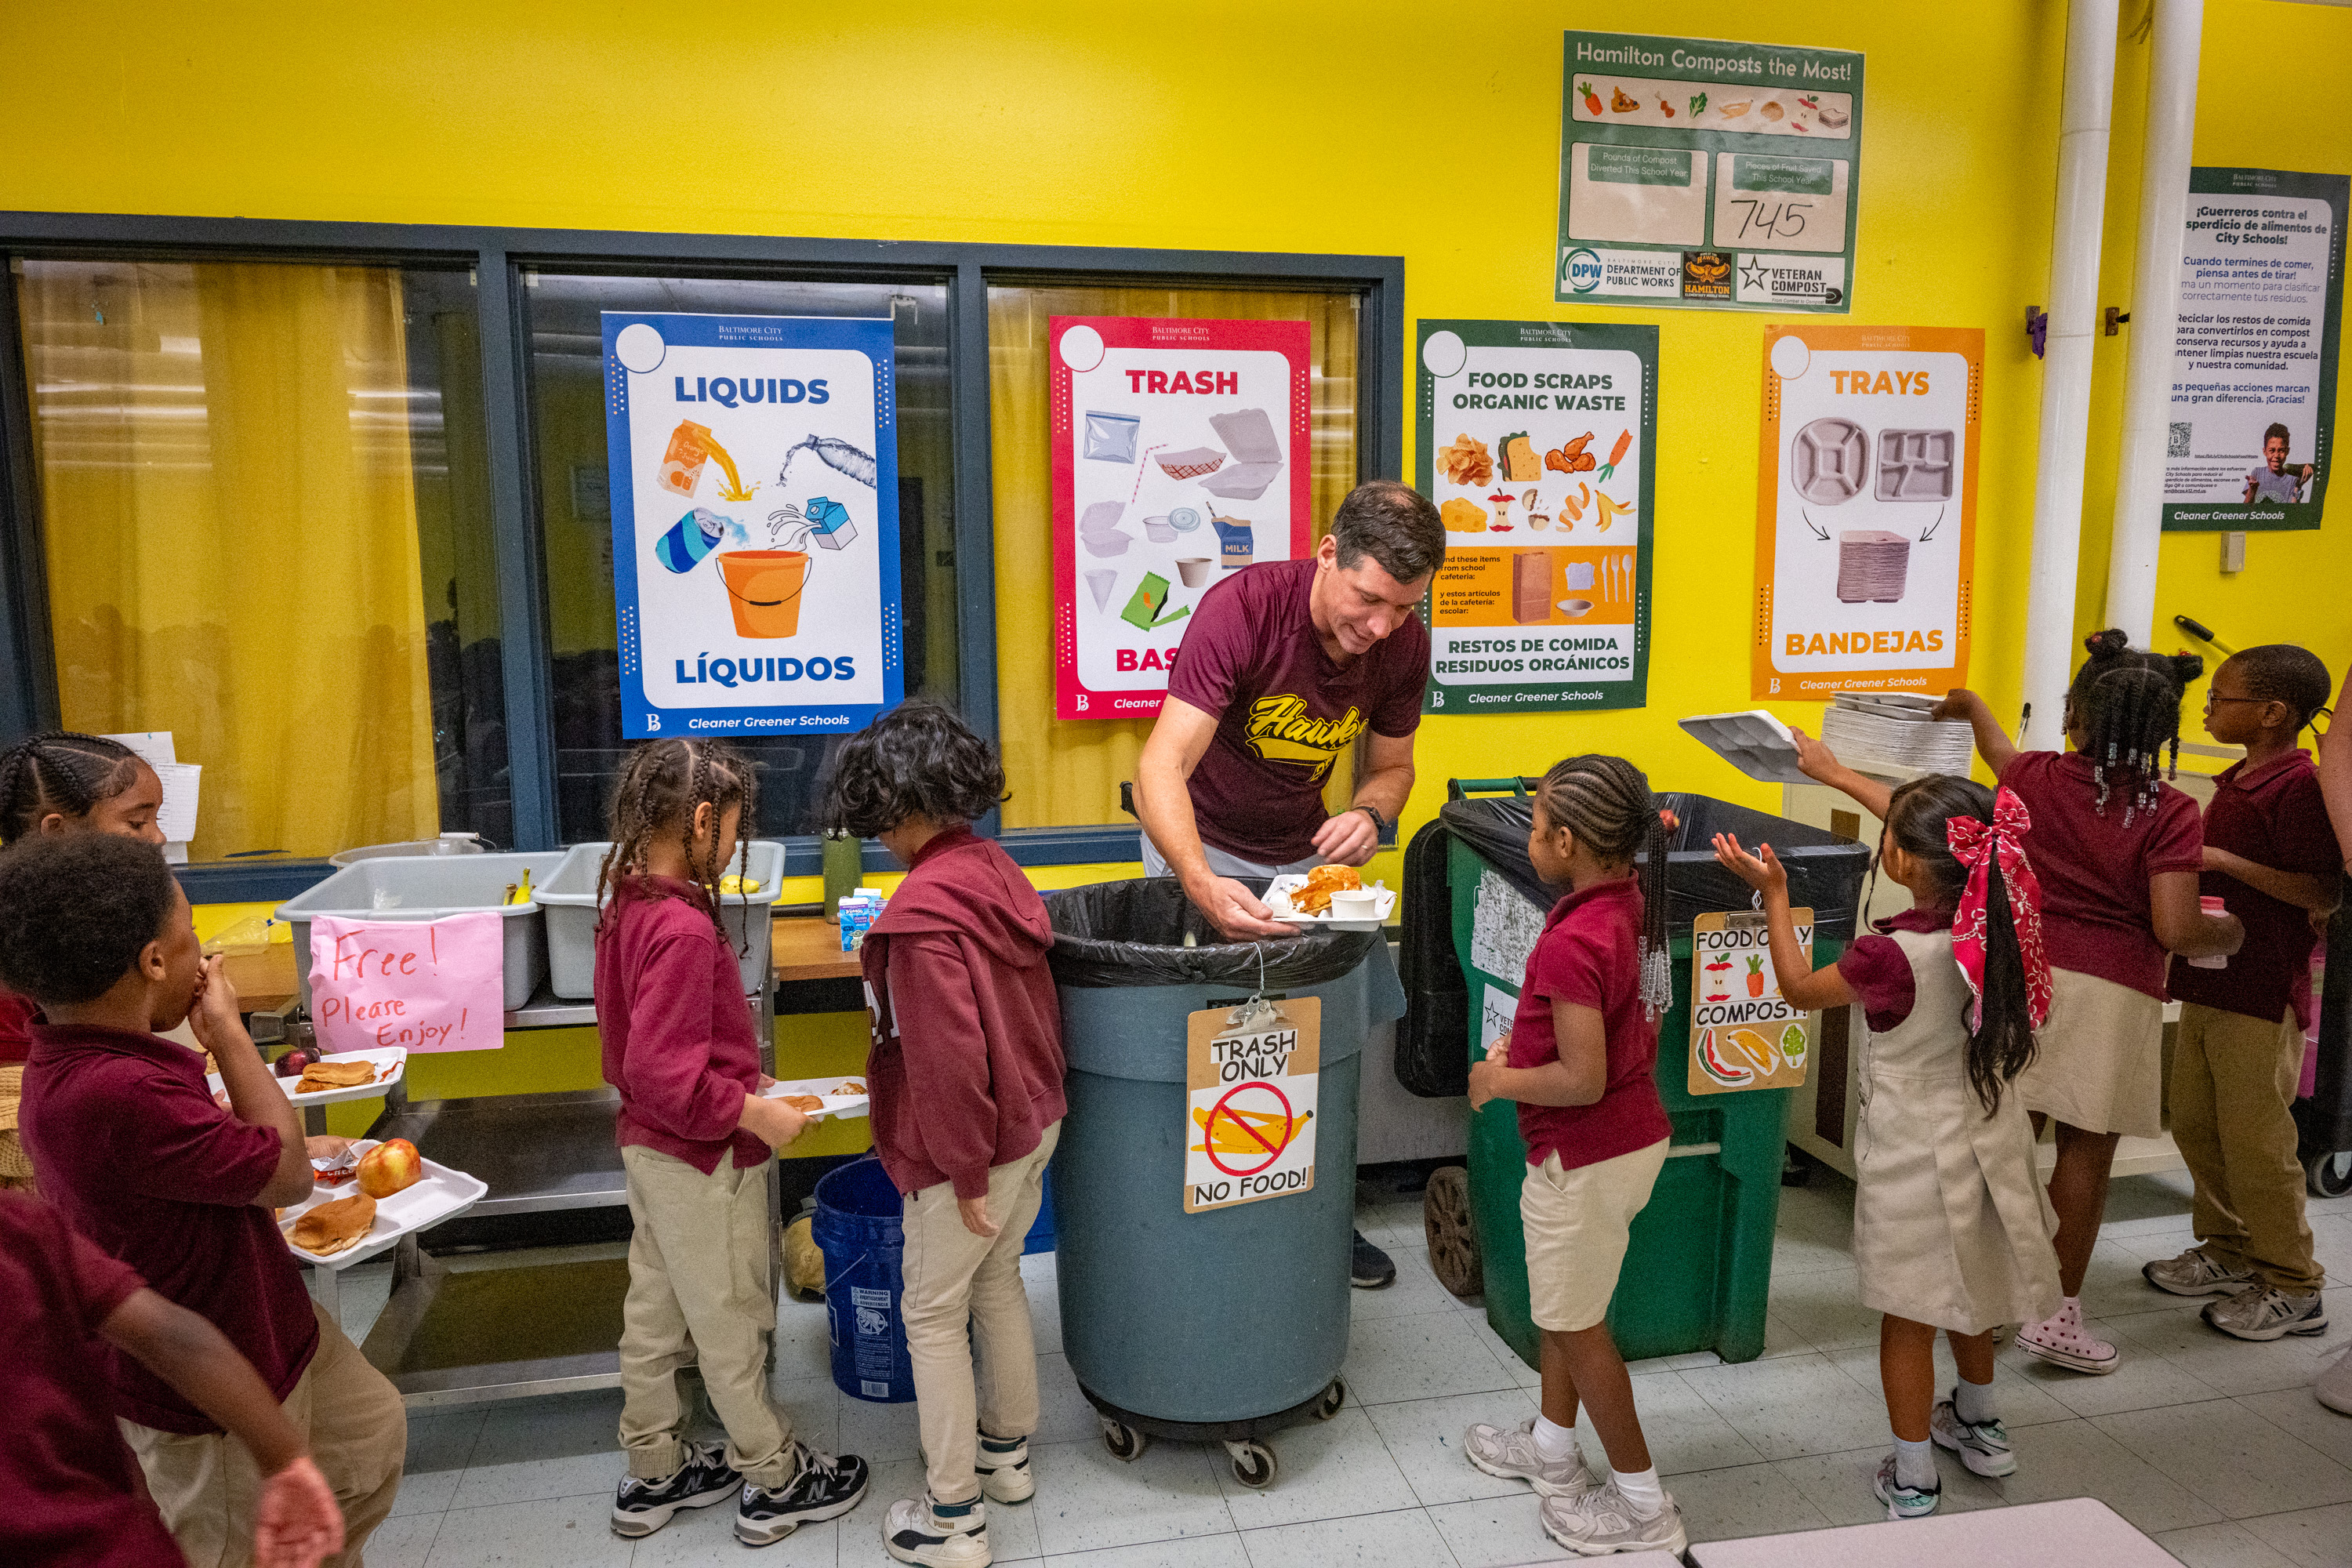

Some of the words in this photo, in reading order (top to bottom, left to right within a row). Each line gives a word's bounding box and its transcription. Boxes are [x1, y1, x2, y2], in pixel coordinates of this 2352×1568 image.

[1577, 42, 1664, 67] Hamilton
[1671, 49, 1762, 75] Composts
[1768, 57, 1796, 77] the
[1803, 60, 1851, 81] Most!
[1602, 152, 1631, 162] Pounds
[1642, 155, 1677, 165] Compost
[1591, 163, 1622, 172] Diverted
[1642, 167, 1668, 176] School
[1745, 162, 1770, 170] Pieces
[1781, 163, 1797, 172] Fruit
[1798, 165, 1821, 173] Saved
[1752, 173, 1767, 182] This
[1769, 174, 1794, 183] School
[1730, 199, 1813, 239] 745
[2197, 206, 2259, 218] ¡Guerreros
[2262, 209, 2296, 220] contra
[2298, 210, 2307, 220] el
[2186, 220, 2241, 230] sperdicio
[2244, 220, 2258, 230] de
[2261, 220, 2312, 234] alimentos
[2314, 224, 2327, 234] de
[2216, 232, 2240, 245] City
[2242, 234, 2288, 245] Schools!
[1697, 256, 1720, 265] HAWKS
[2183, 256, 2222, 266] Cuando
[2225, 257, 2267, 267] termines
[2270, 259, 2281, 267] de
[2284, 260, 2314, 270] comer,
[1572, 263, 1602, 279] DPW
[1607, 265, 1664, 276] DEPARTMENT
[1668, 267, 1681, 276] OF
[1772, 268, 1822, 281] VETERAN
[2196, 268, 2229, 279] piensa
[2232, 270, 2259, 278] antes
[2261, 270, 2274, 279] de
[1606, 276, 1639, 286] PUBLIC
[1642, 278, 1675, 288] WORKS
[1771, 281, 1827, 293] COMPOST
[2263, 283, 2282, 292] para
[2285, 282, 2321, 292] clasificar
[1684, 285, 1730, 295] HAMILTON
[2183, 292, 2252, 301] correctamente
[2270, 293, 2308, 303] residuos.
[2217, 314, 2230, 323] los
[2233, 316, 2261, 325] restos
[2263, 316, 2275, 325] de
[2278, 317, 2310, 325] comida
[718, 325, 762, 334] BALTIMORE
[764, 326, 782, 335] CITY
[2198, 326, 2253, 336] convertirlos
[2263, 340, 2269, 349] y
[2270, 339, 2299, 348] ayuda
[2210, 349, 2244, 359] limpias
[2189, 361, 2194, 370] y
[2234, 361, 2288, 370] comunidad.
[1125, 369, 1239, 395] TRASH
[1468, 372, 1529, 388] FOOD
[1534, 374, 1613, 390] SCRAPS
[1830, 370, 1930, 395] TRAYS
[675, 376, 830, 408] LIQUIDS
[2185, 383, 2230, 393] pequeñas
[2233, 383, 2273, 392] acciones
[1453, 394, 1548, 409] ORGANIC
[1554, 395, 1626, 411] WASTE
[2191, 395, 2213, 405] gran
[2216, 394, 2264, 403] diferencia.
[2266, 395, 2305, 405] ¡Gracias!
[2174, 511, 2210, 521] Cleaner
[2212, 511, 2249, 521] Greener
[2250, 511, 2285, 520] Schools
[1225, 544, 1249, 554] MILK
[1449, 640, 1516, 654] RESTOS
[1521, 639, 1544, 652] DE
[1549, 637, 1618, 652] COMIDA
[1785, 630, 1944, 655] BANDEJAS
[675, 652, 856, 688] LÍQUIDOS
[1436, 659, 1524, 673] RESIDUOS
[1529, 654, 1630, 671] ORGÁNICOS
[1800, 681, 1842, 690] Cleaner
[1844, 679, 1885, 688] Greener
[1887, 677, 1927, 687] Schools
[1468, 692, 1512, 704] Cleaner
[1515, 691, 1559, 702] Greener
[1560, 690, 1604, 701] Schools
[1113, 699, 1161, 709] Cleaner
[688, 717, 742, 729] Cleaner
[743, 717, 798, 728] Greener
[800, 715, 850, 726] Schools
[1697, 930, 1752, 950] FOOD
[333, 926, 437, 981] Free!
[321, 996, 406, 1027] Please
[376, 1007, 467, 1047] Enjoy!
[1212, 1030, 1296, 1062] TRASH
[1221, 1054, 1287, 1082] ONLY
[1195, 1182, 1230, 1205] NO
[1240, 1167, 1306, 1197] FOOD!
[935, 1520, 955, 1529] PUMA
